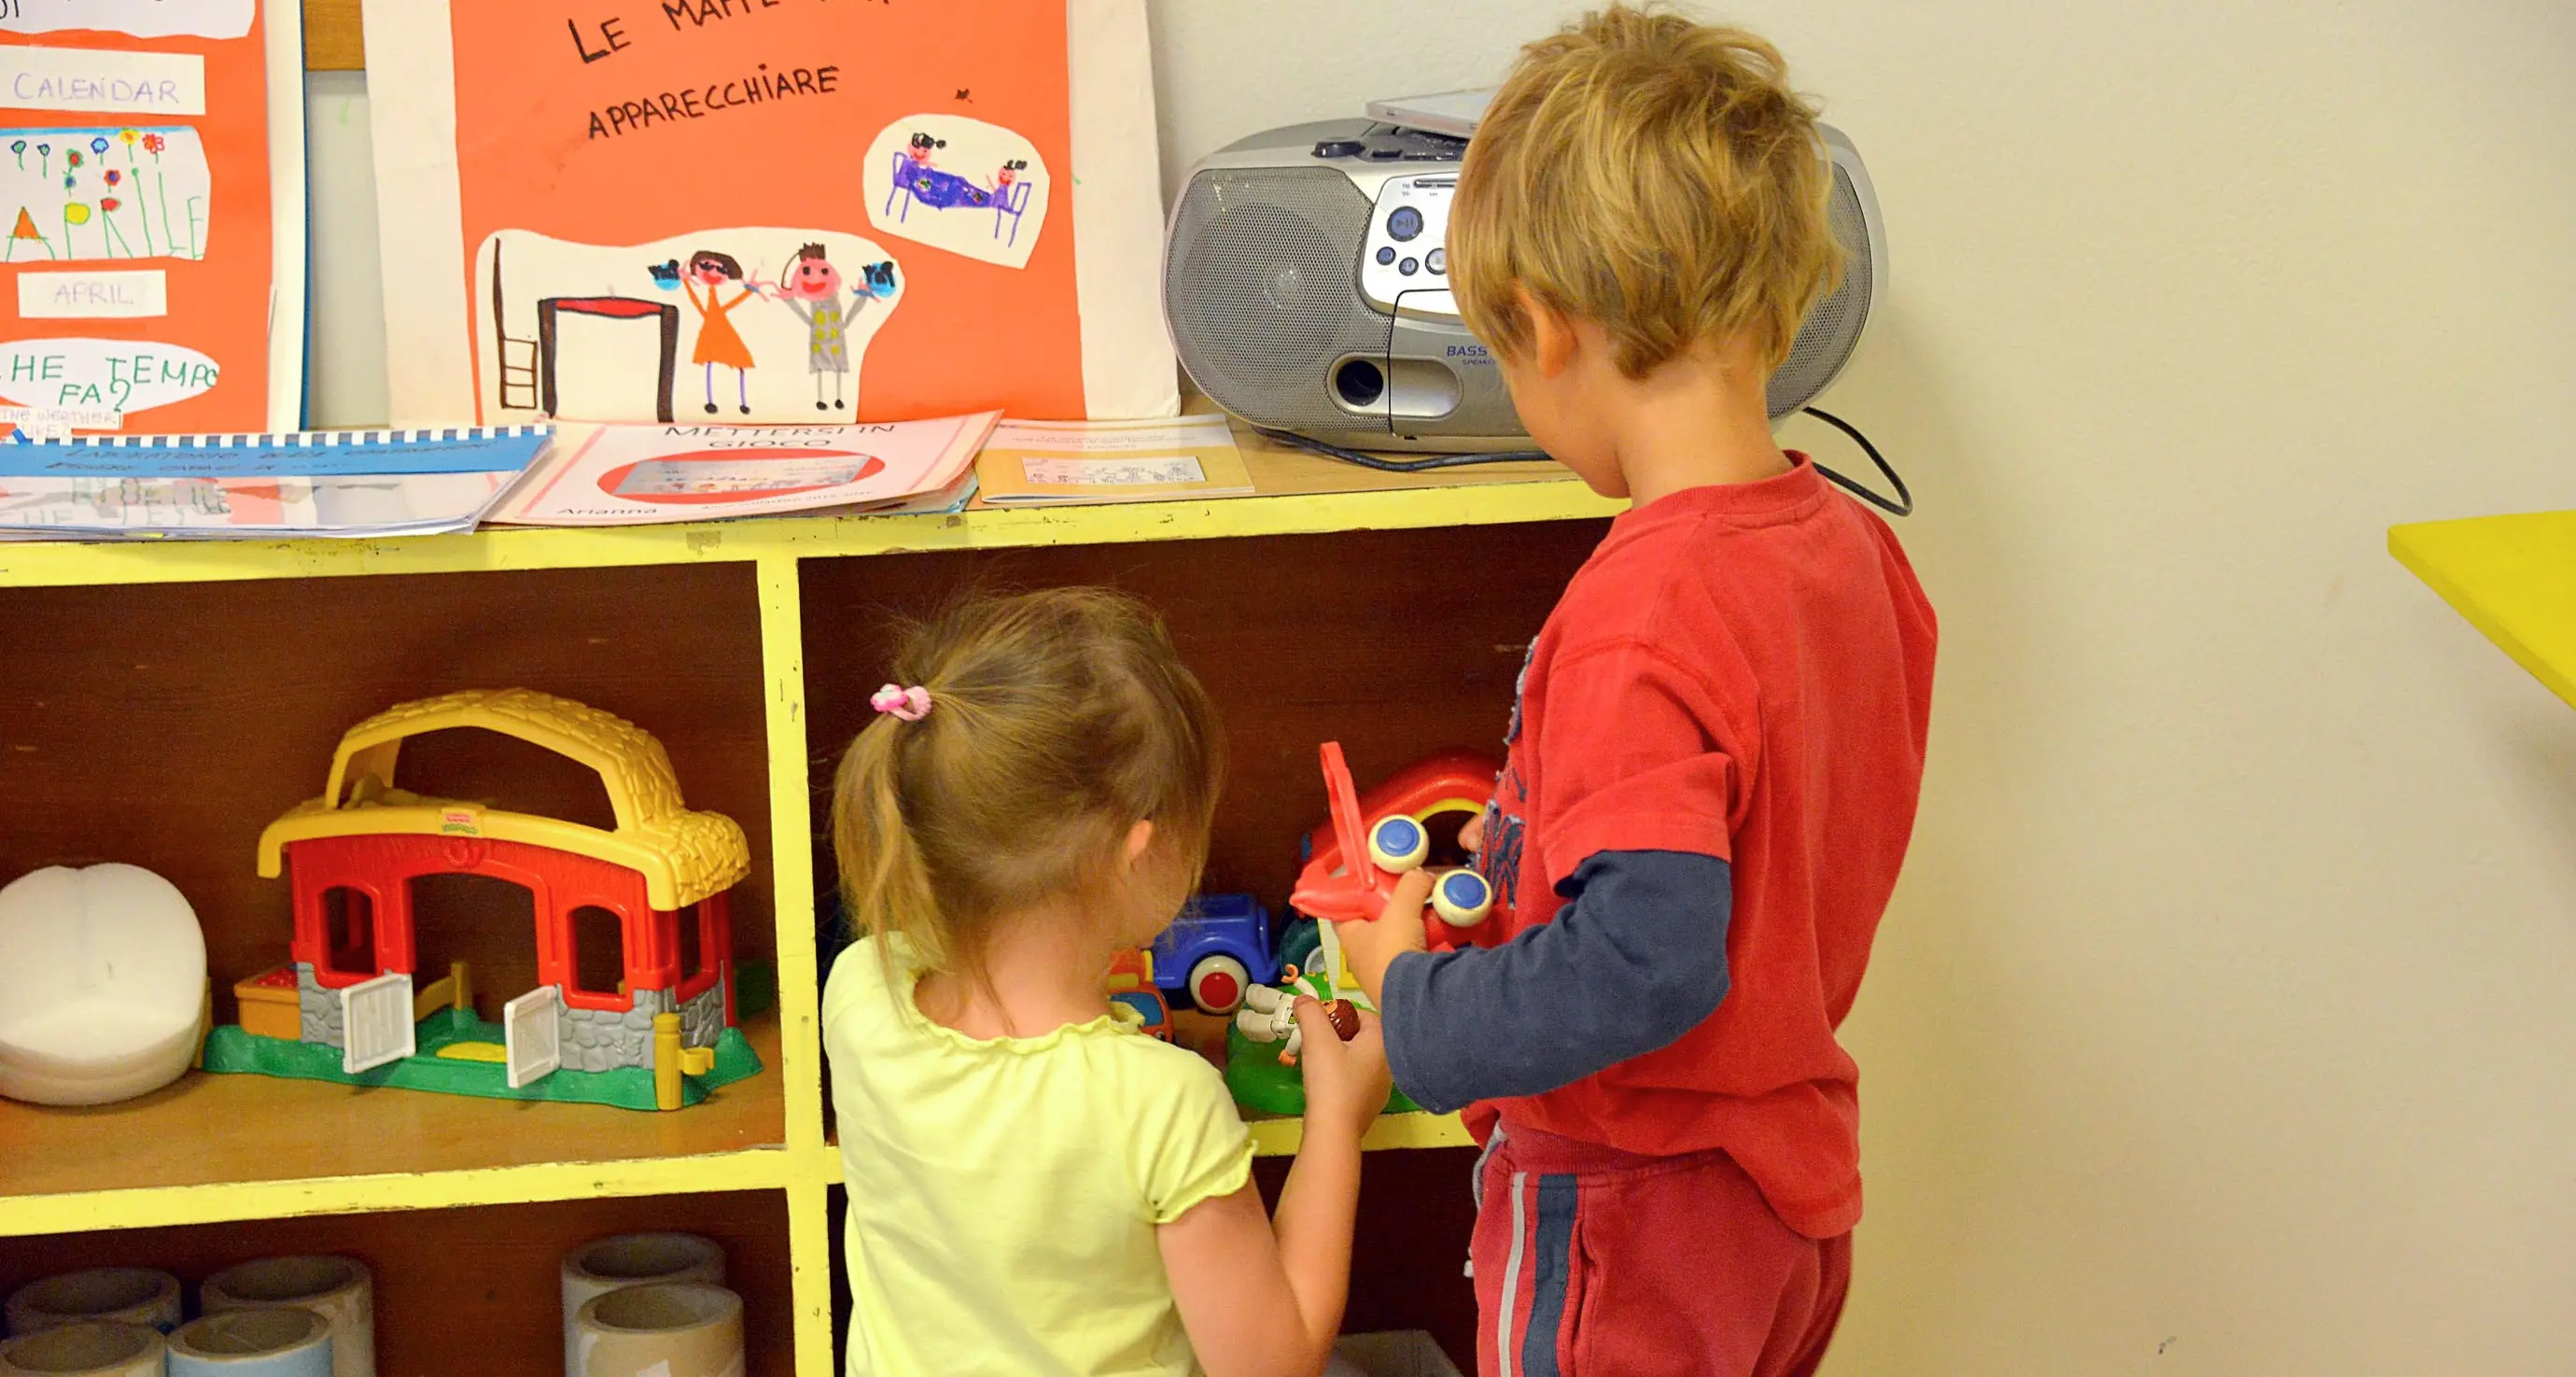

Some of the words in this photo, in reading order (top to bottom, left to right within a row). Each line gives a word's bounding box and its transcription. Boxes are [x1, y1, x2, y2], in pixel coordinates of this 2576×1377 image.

[568, 18, 631, 63] LE
[13, 72, 180, 104] CALENDAR
[589, 63, 839, 139] APPARECCHIARE
[53, 281, 134, 304] APRIL
[1447, 345, 1488, 357] BASS
[0, 354, 65, 381] HE
[665, 426, 844, 437] METTERSI
[859, 424, 896, 433] IN
[709, 439, 832, 448] GIOCO
